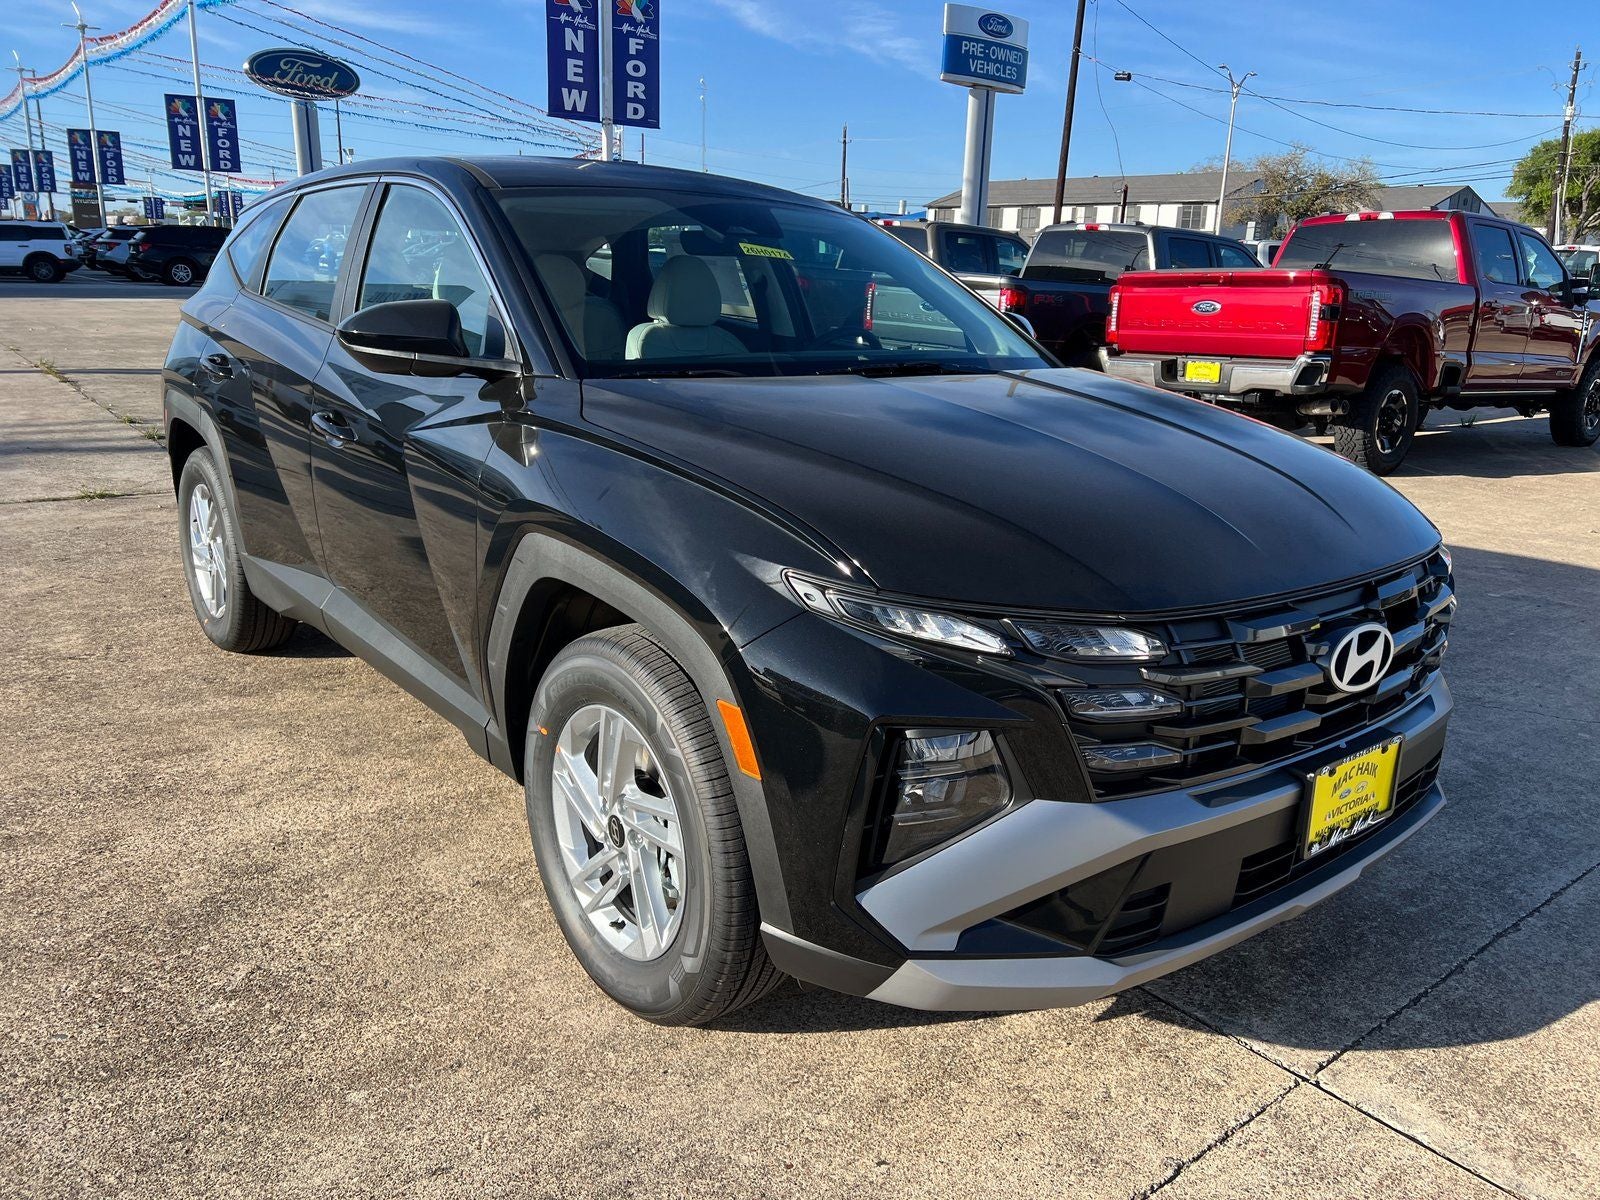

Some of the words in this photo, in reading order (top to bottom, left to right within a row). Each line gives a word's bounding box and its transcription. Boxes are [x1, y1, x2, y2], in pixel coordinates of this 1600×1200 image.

[987, 16, 1008, 33] Ford
[273, 57, 339, 91] Ford
[561, 27, 588, 113] NEW
[625, 37, 647, 120] FORD
[969, 58, 1017, 80] VEHICLES
[177, 124, 196, 167] NEW
[217, 127, 232, 170] FORD
[17, 165, 30, 190] NEW
[76, 150, 90, 181] NEW
[106, 152, 118, 183] FORD
[1034, 294, 1065, 305] FX4
[1331, 765, 1356, 798] MAC
[1355, 761, 1379, 779] HAIK
[1331, 793, 1370, 819] VICTORIA
